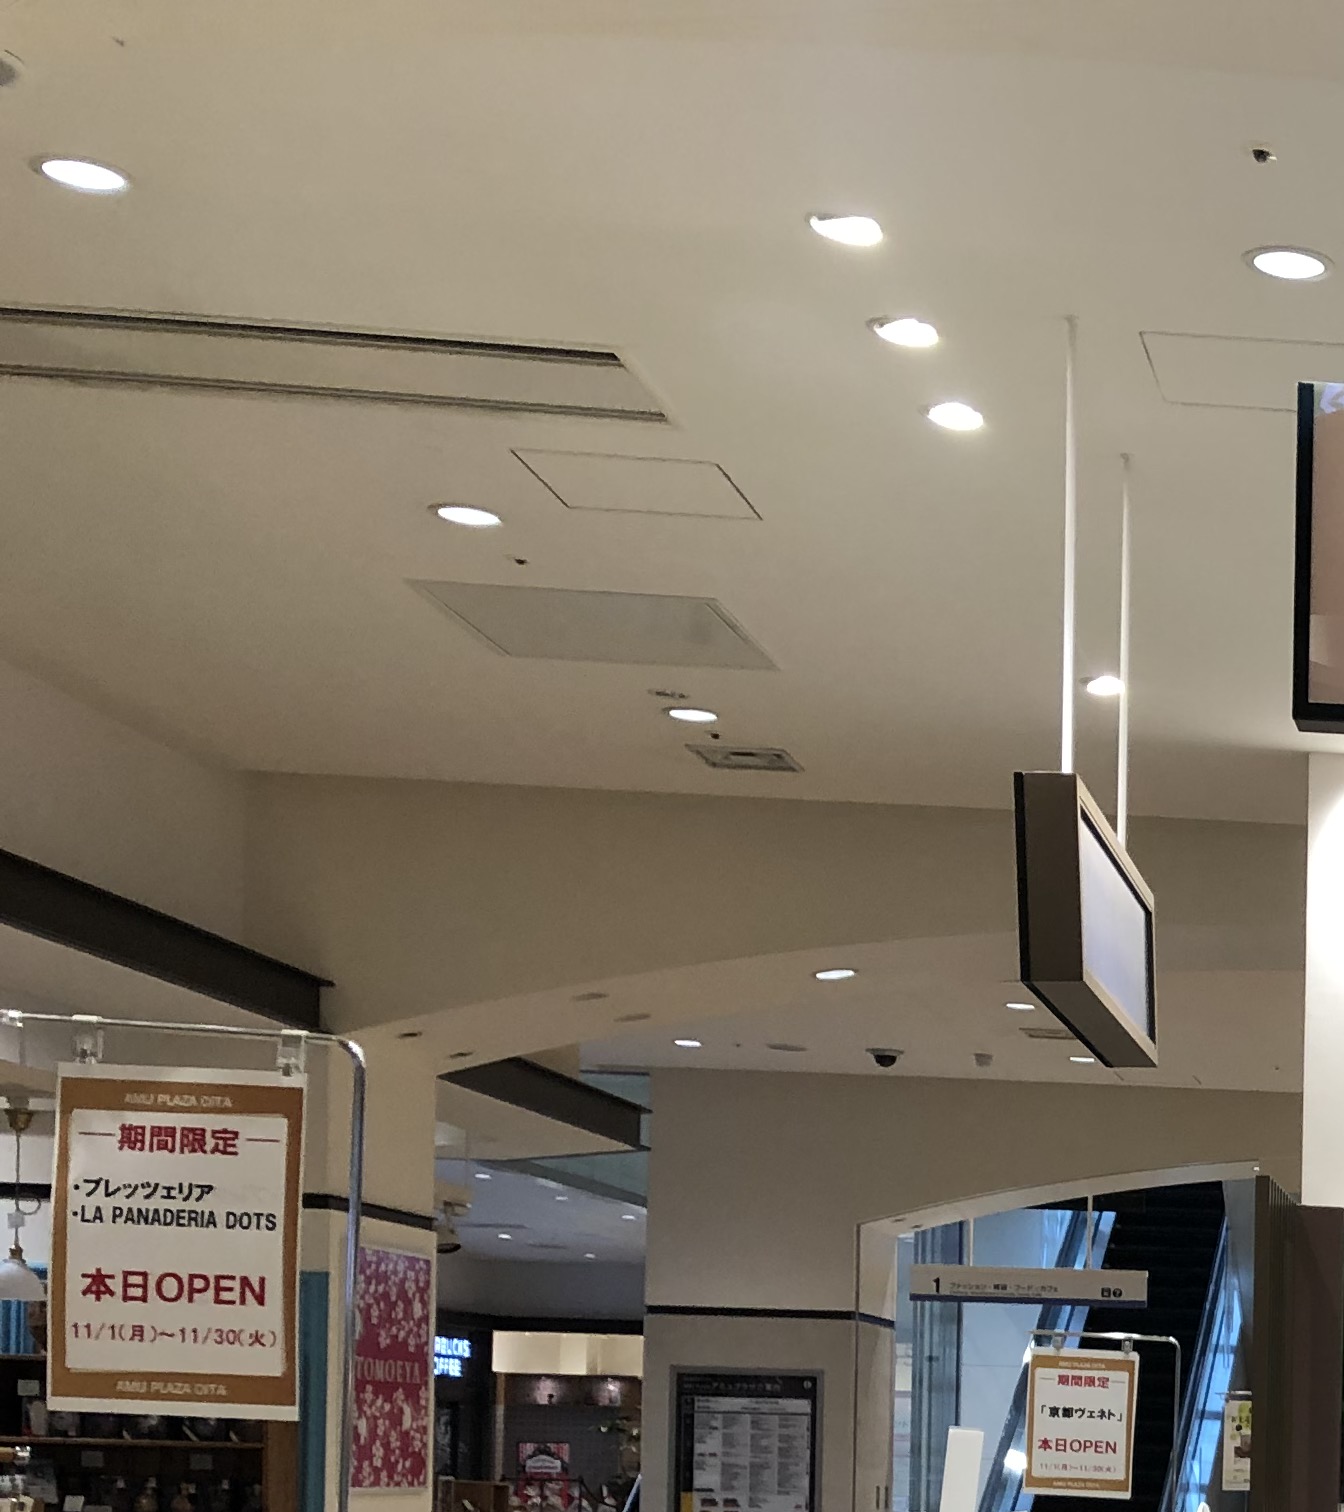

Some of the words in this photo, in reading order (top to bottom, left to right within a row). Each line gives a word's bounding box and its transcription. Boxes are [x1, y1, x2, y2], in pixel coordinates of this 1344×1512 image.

[156, 1095, 198, 1107] PLAZA
[118, 1123, 239, 1156] 期間限定
[112, 1207, 217, 1229] PANADERIA
[225, 1211, 277, 1231] DOTS
[81, 1267, 266, 1306] 本日OPEN
[932, 1277, 941, 1294] 1
[151, 1381, 191, 1395] PLAZA
[1058, 1374, 1110, 1389] 期間限定
[1037, 1438, 1117, 1454] 本日OPEN
